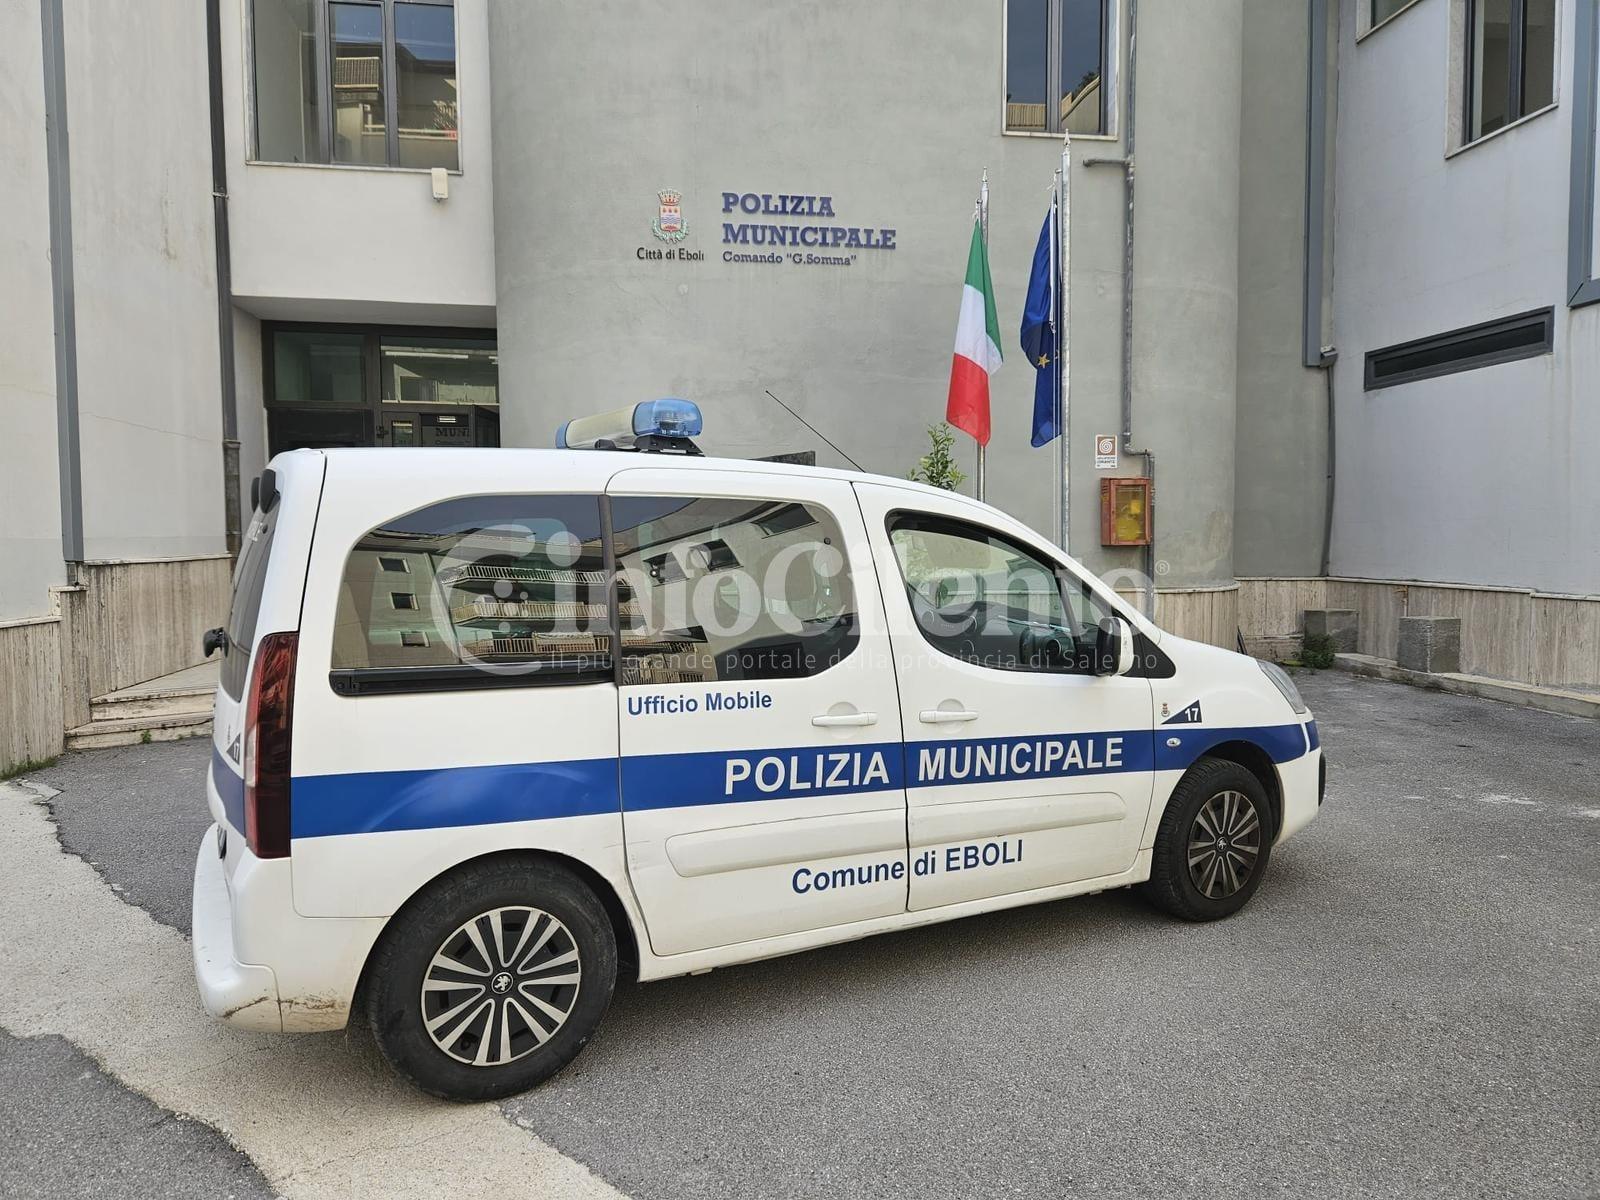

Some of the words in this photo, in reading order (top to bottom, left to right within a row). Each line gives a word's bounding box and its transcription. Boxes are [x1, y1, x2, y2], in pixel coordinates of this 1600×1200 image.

[722, 192, 835, 217] POLIZIA
[722, 223, 896, 249] MUNICIPALE
[637, 247, 663, 260] Città
[666, 249, 676, 260] di
[679, 248, 704, 261] Eboli
[723, 251, 783, 264] Comando
[627, 695, 698, 716] Ufficio
[705, 690, 772, 711] Mobile
[1185, 707, 1199, 721] 17
[725, 751, 890, 795] POLIZIA
[918, 737, 1124, 782] MUNICIPALE
[792, 860, 905, 894] Comune
[914, 850, 936, 876] di
[945, 839, 1023, 872] EBOLI
